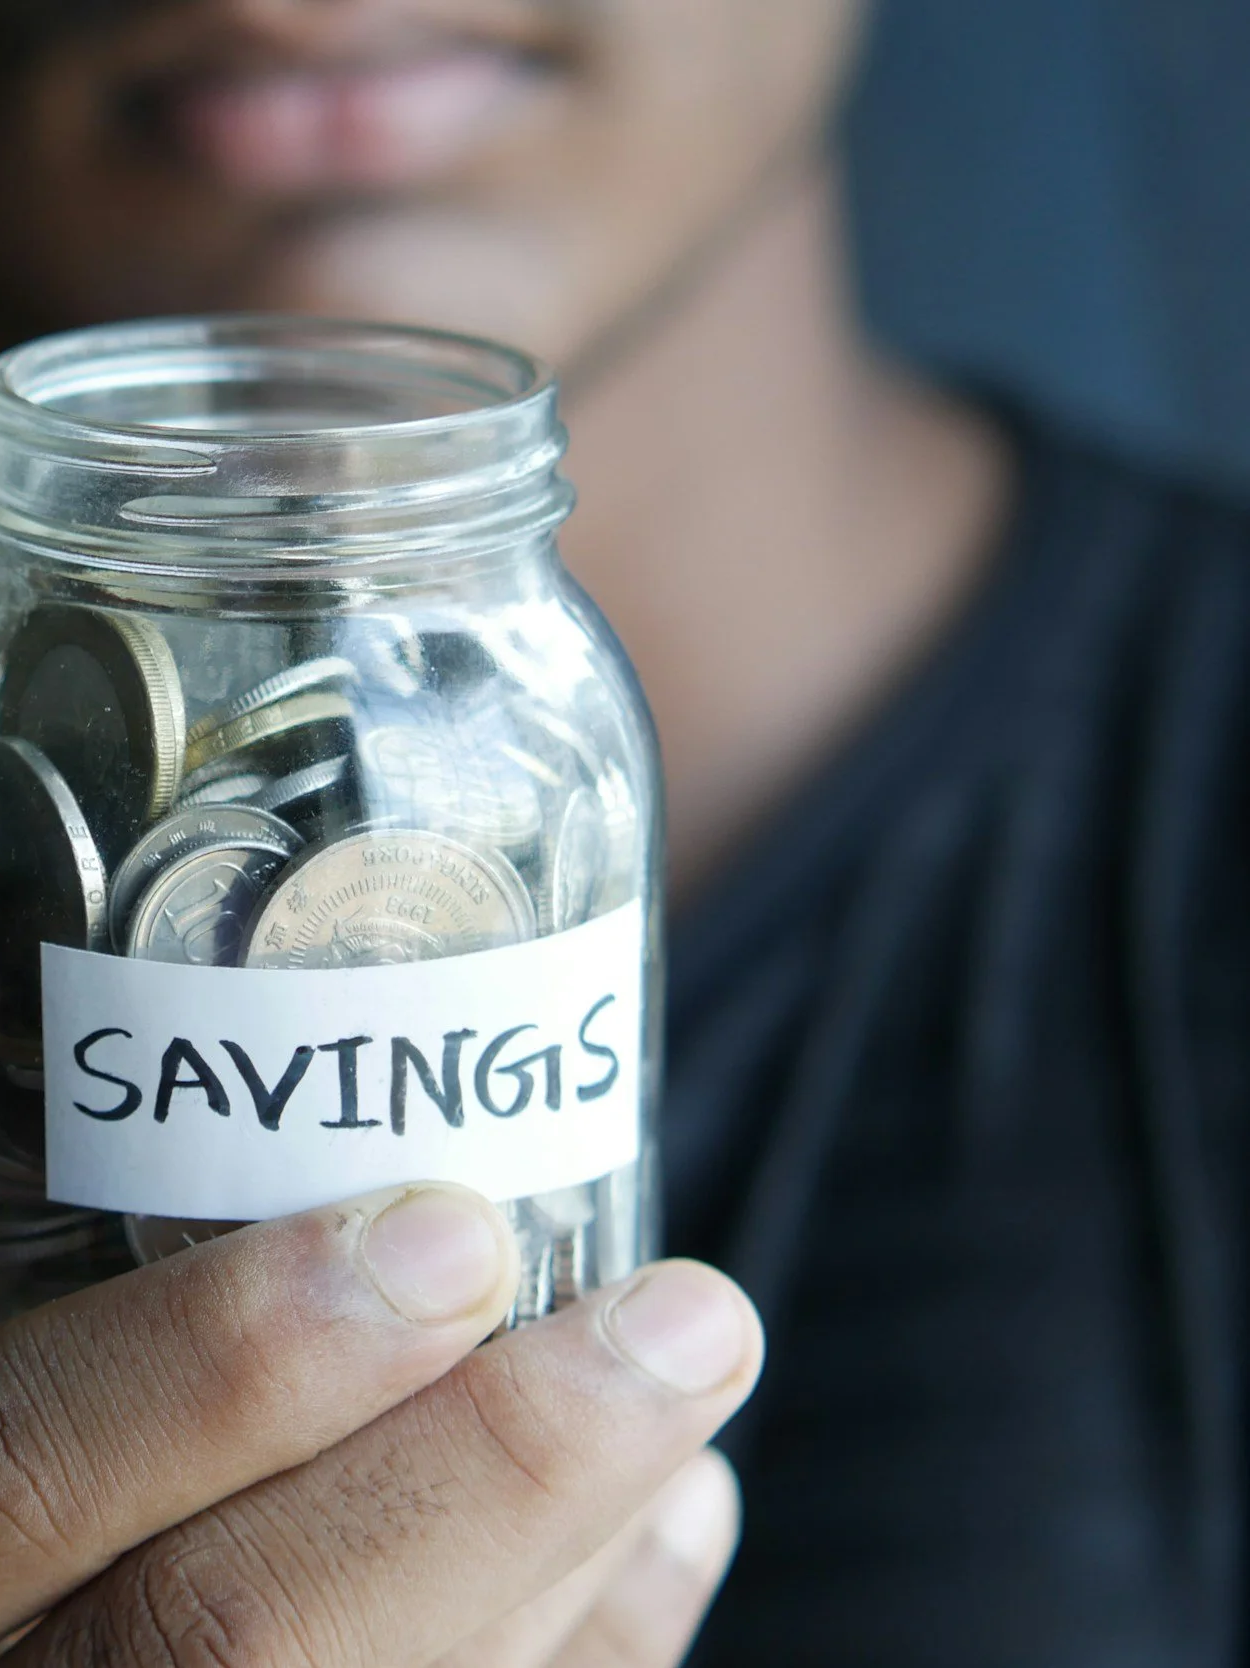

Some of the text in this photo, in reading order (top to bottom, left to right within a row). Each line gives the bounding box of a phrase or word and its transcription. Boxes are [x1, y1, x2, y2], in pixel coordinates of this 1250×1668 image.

[360, 845, 491, 906] SINGAPORE
[384, 894, 437, 925] 1993
[73, 994, 619, 1136] SAVINGS
